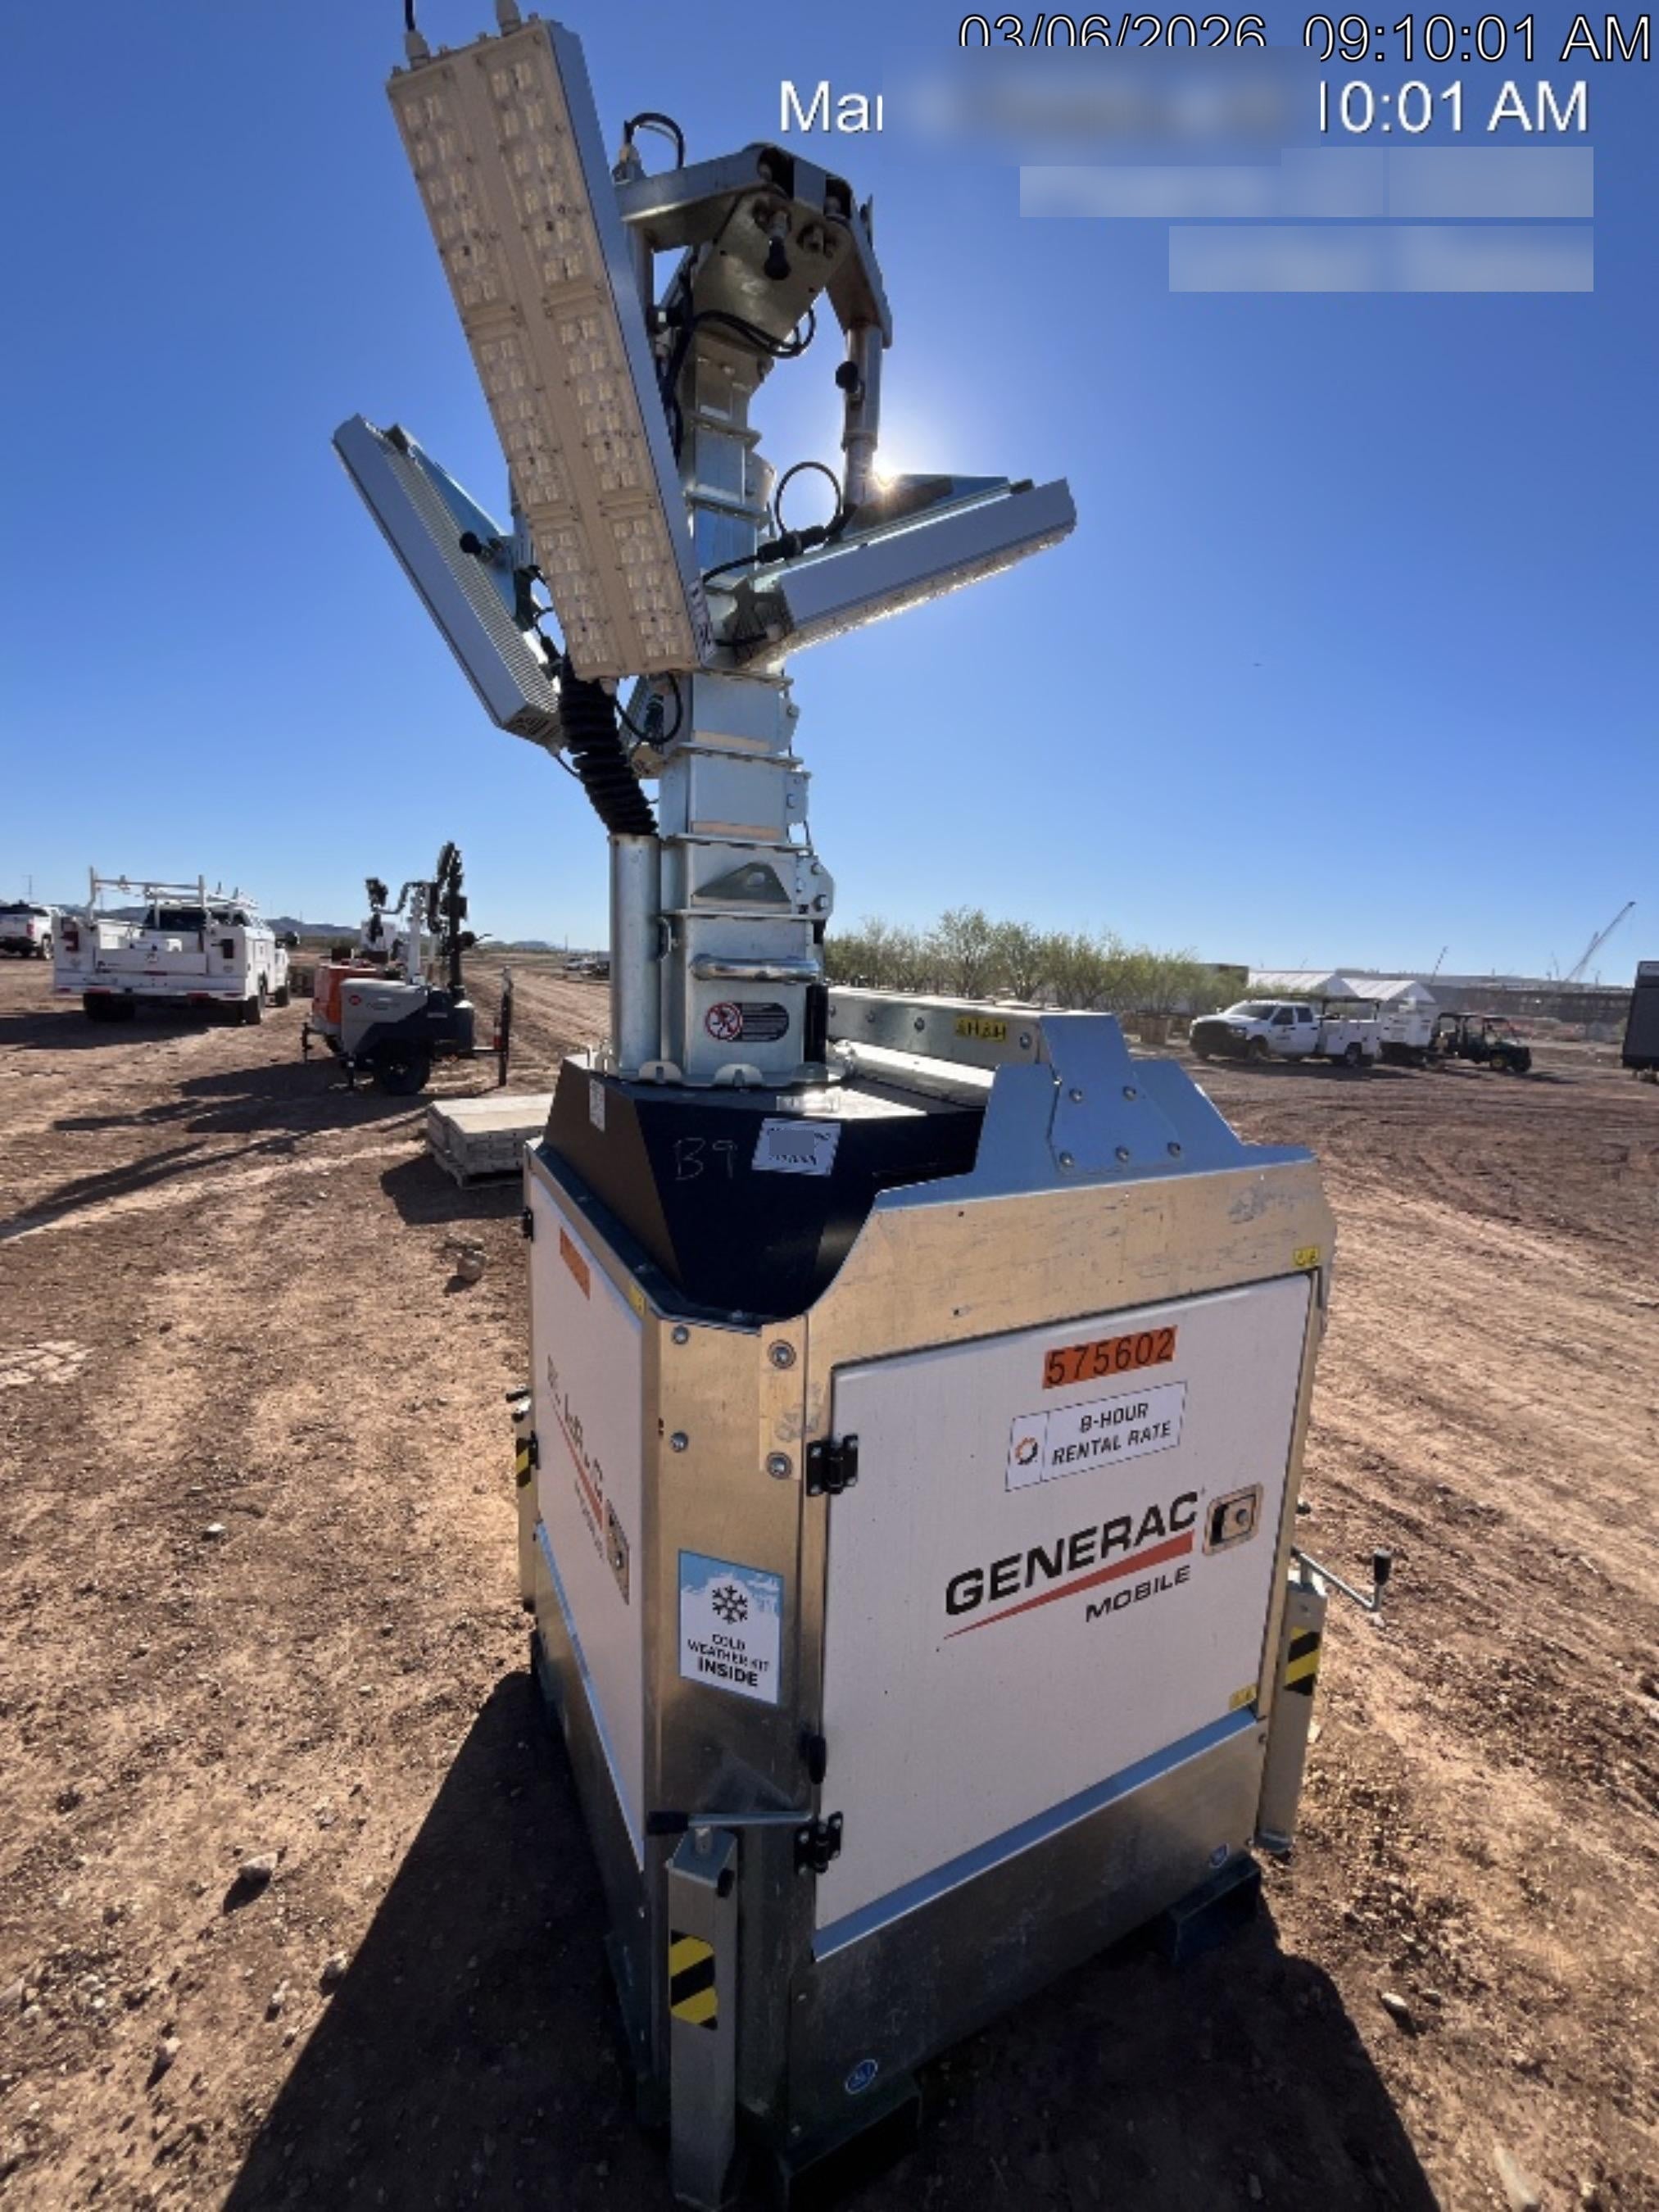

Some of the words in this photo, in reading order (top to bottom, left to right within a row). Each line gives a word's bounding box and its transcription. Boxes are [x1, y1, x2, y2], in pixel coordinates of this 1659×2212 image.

[1046, 1327, 1173, 1385] 575602
[1080, 1403, 1149, 1433] 8-HOUR
[1052, 1435, 1122, 1466] RENTAL
[1127, 1420, 1172, 1446] RATE
[946, 1491, 1198, 1615] GENERAC
[1086, 1565, 1191, 1622] MOBILE
[687, 1638, 748, 1667] WEATHER
[712, 1634, 746, 1650] COLD
[698, 1655, 759, 1687] INSIDE
